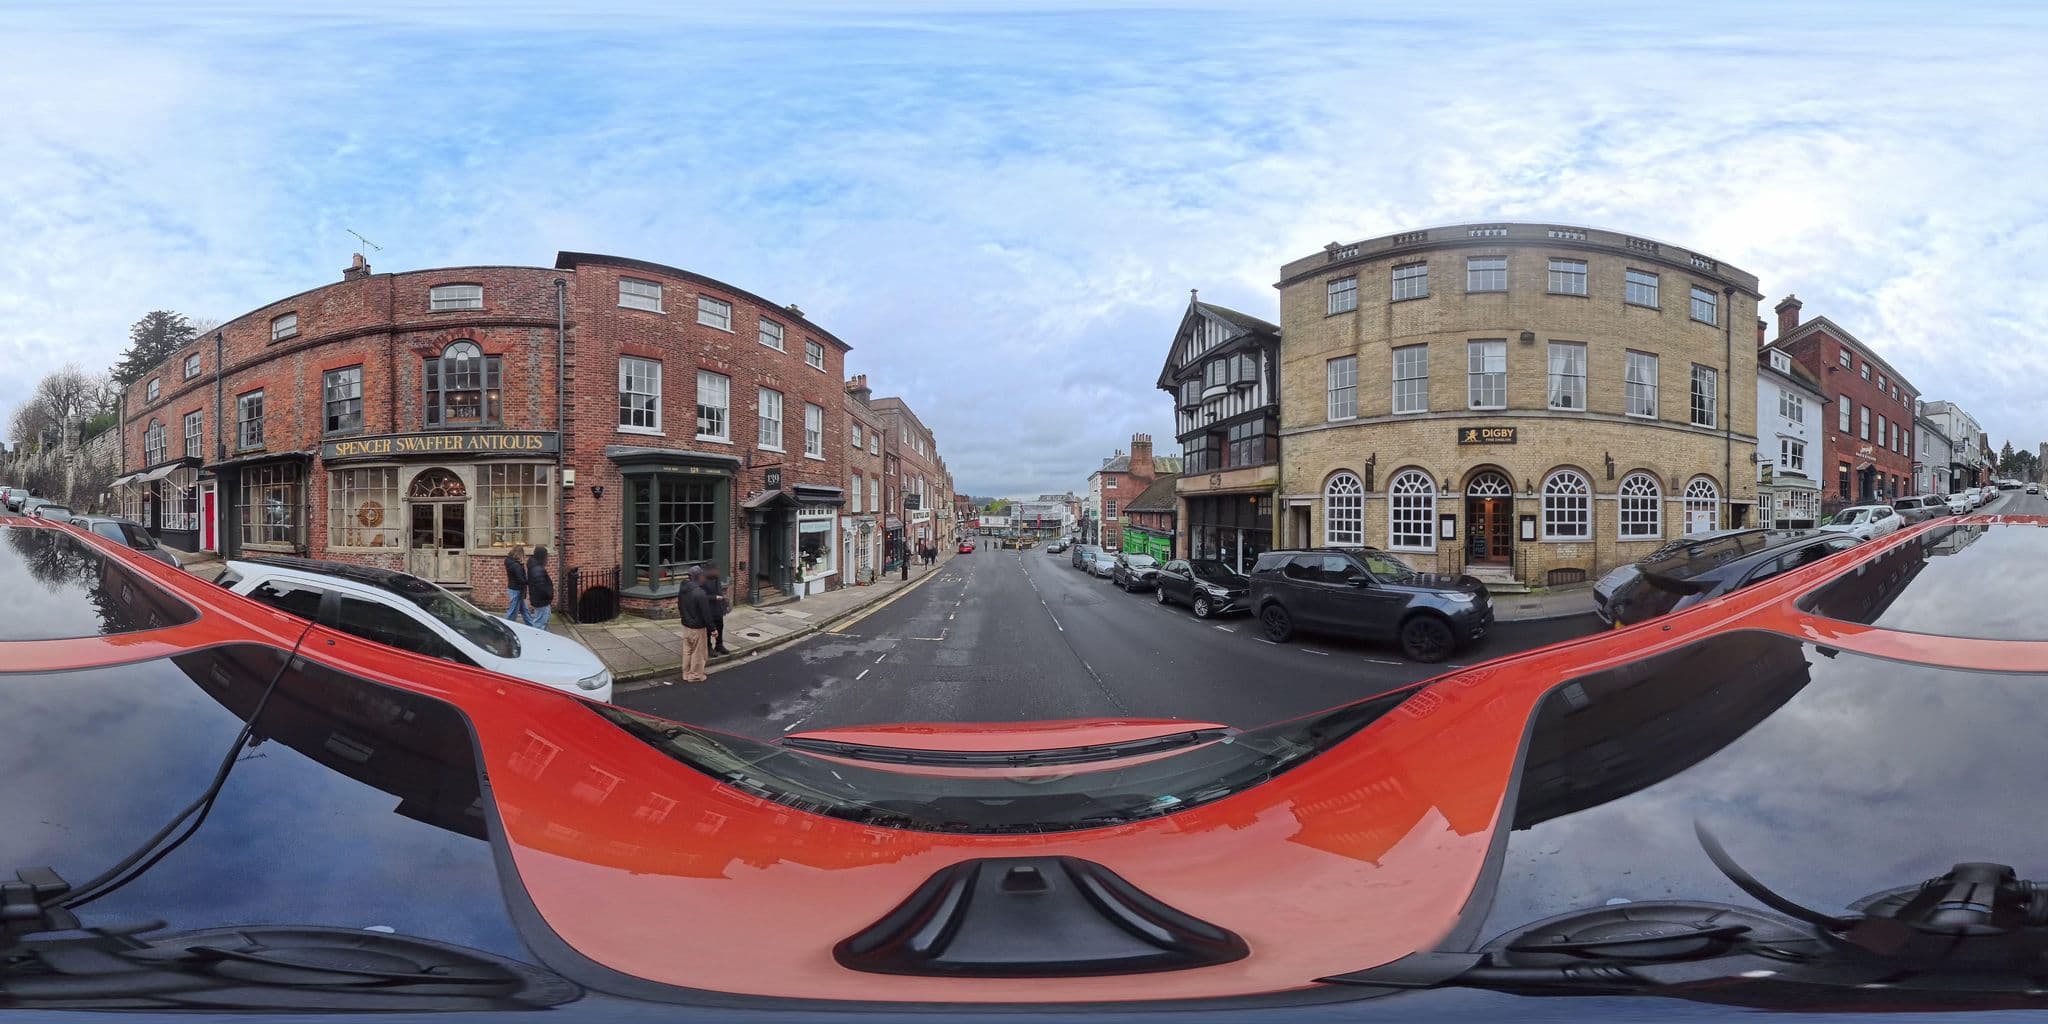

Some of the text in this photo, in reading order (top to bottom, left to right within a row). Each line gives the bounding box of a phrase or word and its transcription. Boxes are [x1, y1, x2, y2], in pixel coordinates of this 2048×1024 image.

[1482, 428, 1513, 437] DIGBY
[335, 435, 543, 456] SPENCER SWAFFER ANTIQUES
